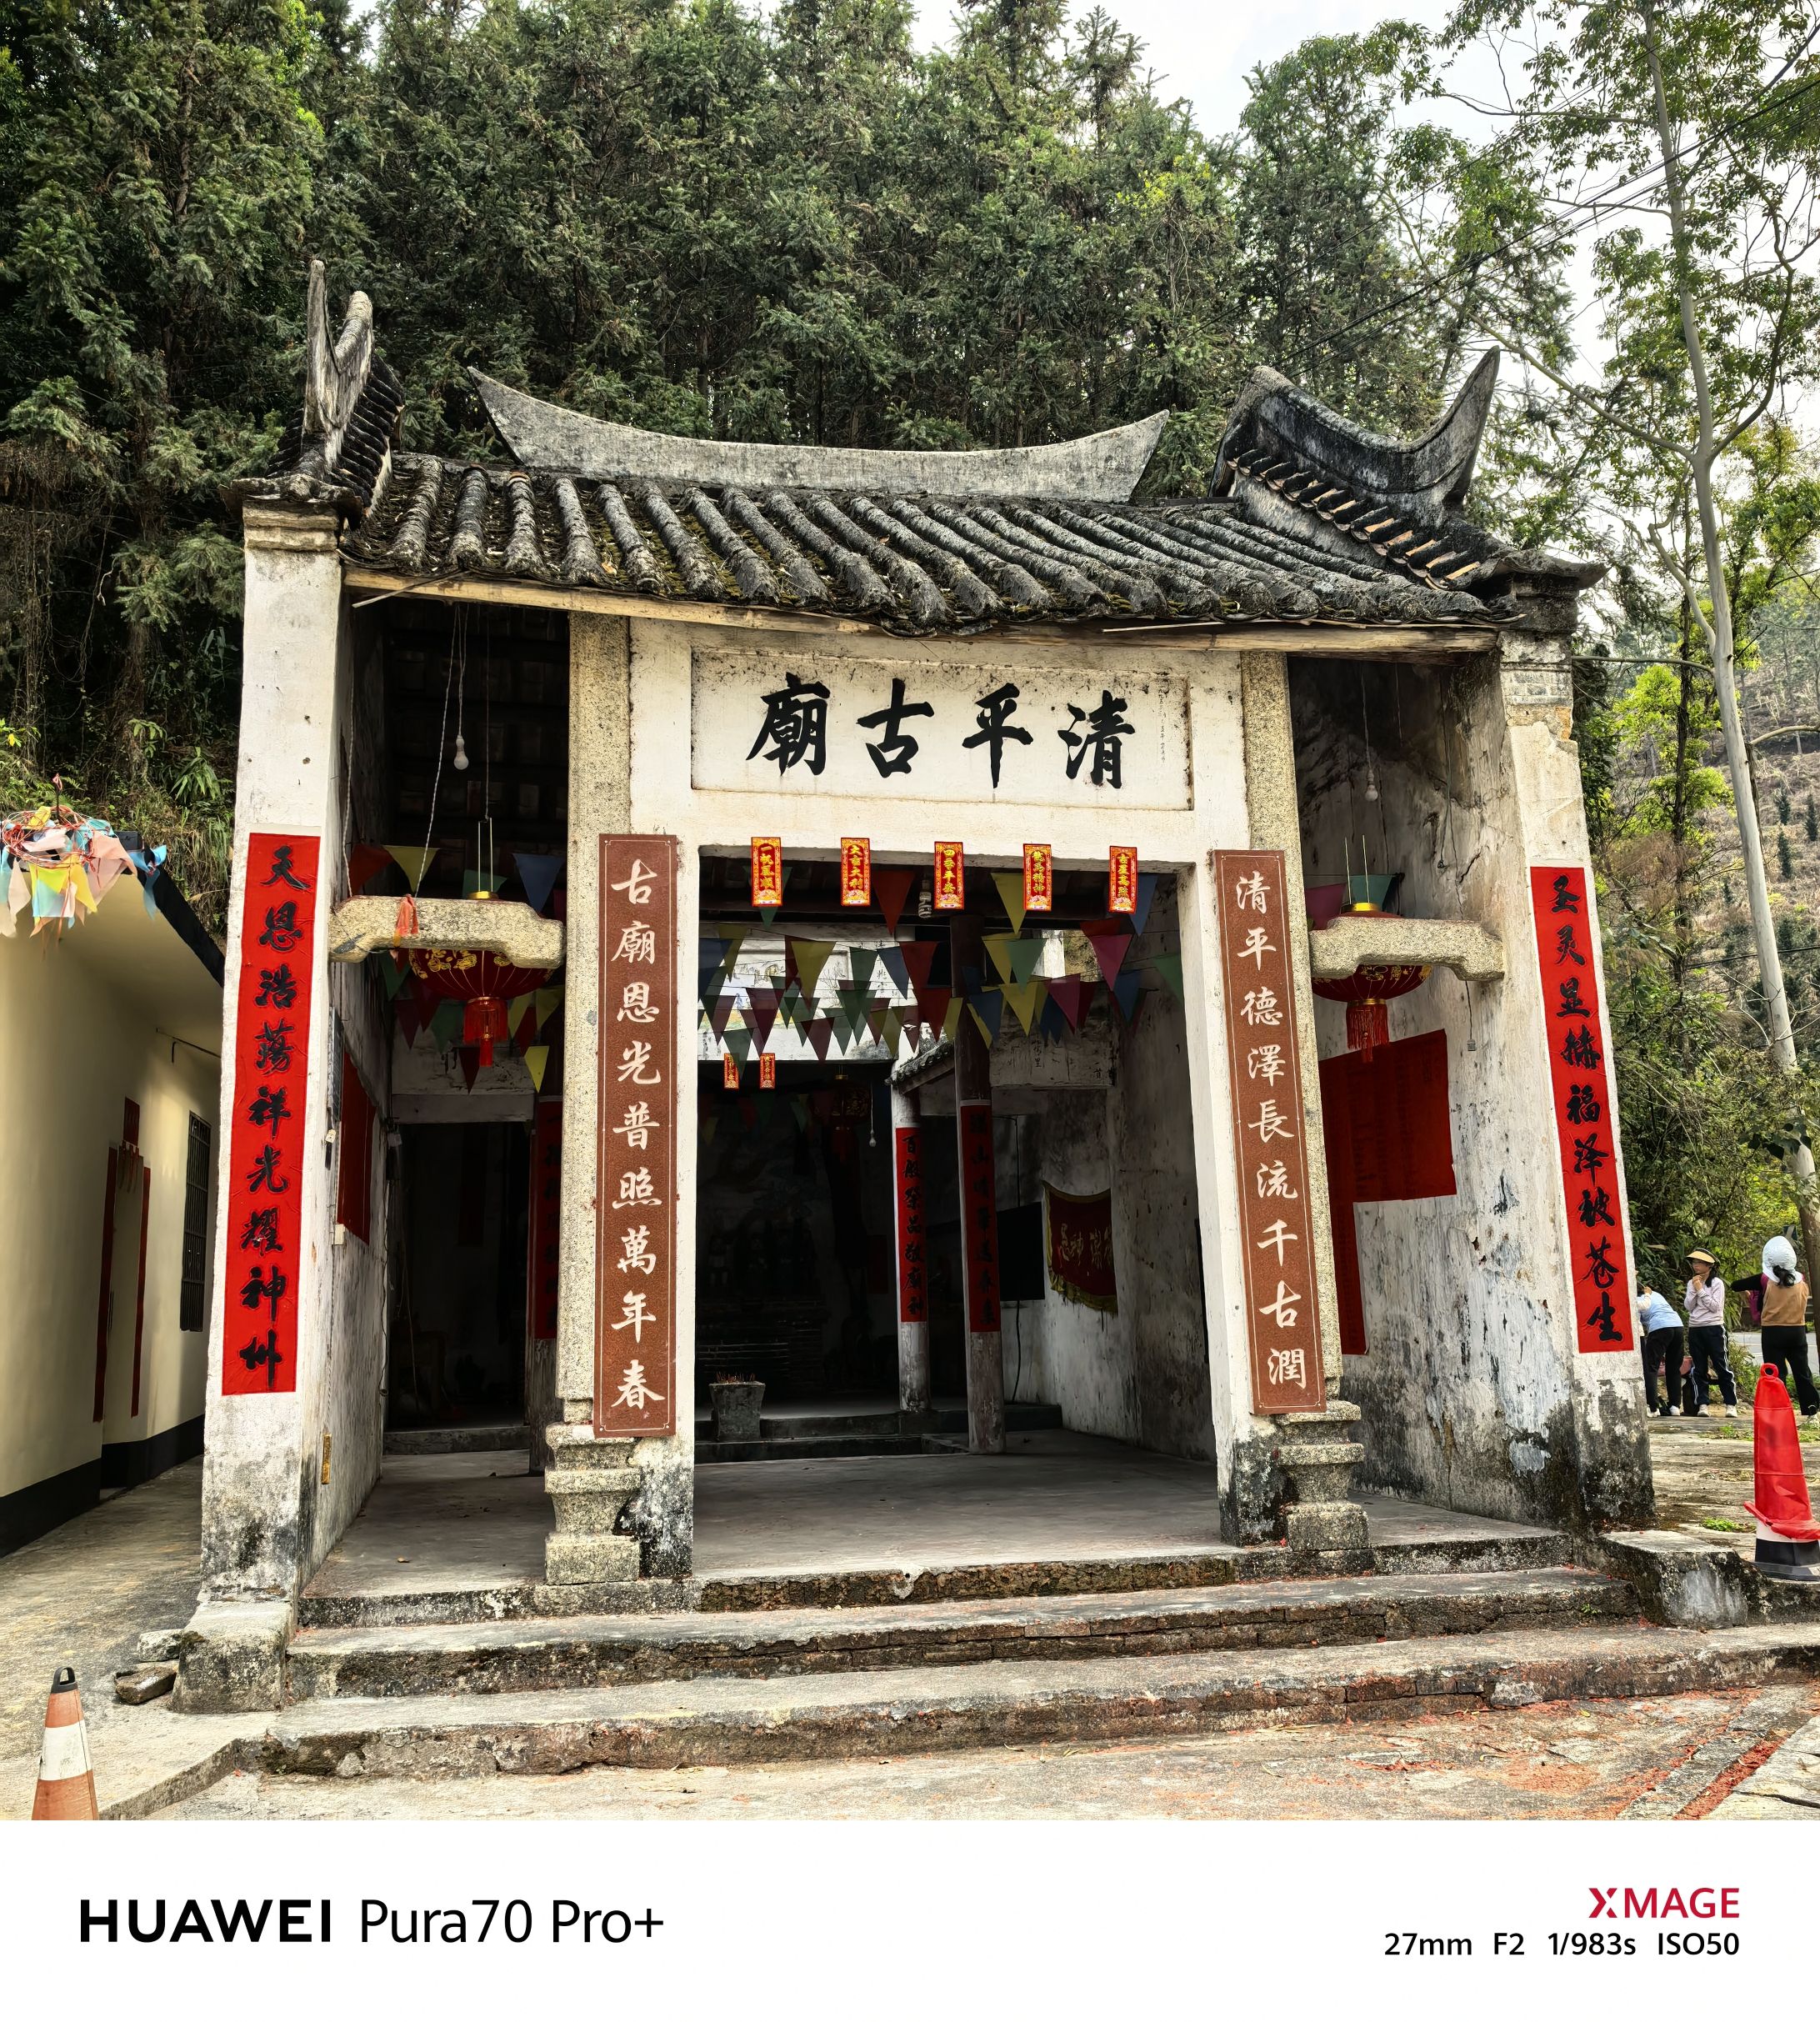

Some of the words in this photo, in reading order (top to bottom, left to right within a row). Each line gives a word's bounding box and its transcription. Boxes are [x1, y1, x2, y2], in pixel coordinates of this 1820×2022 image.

[746, 672, 1135, 788] 清平古廟
[848, 844, 864, 889] 大吉大利
[942, 848, 956, 893] 四季平安
[1117, 853, 1130, 898] 吉星高照
[611, 858, 666, 1410] 古廟恩光普照萬年春
[1236, 870, 1308, 1389] 清平德澤長流千古潤
